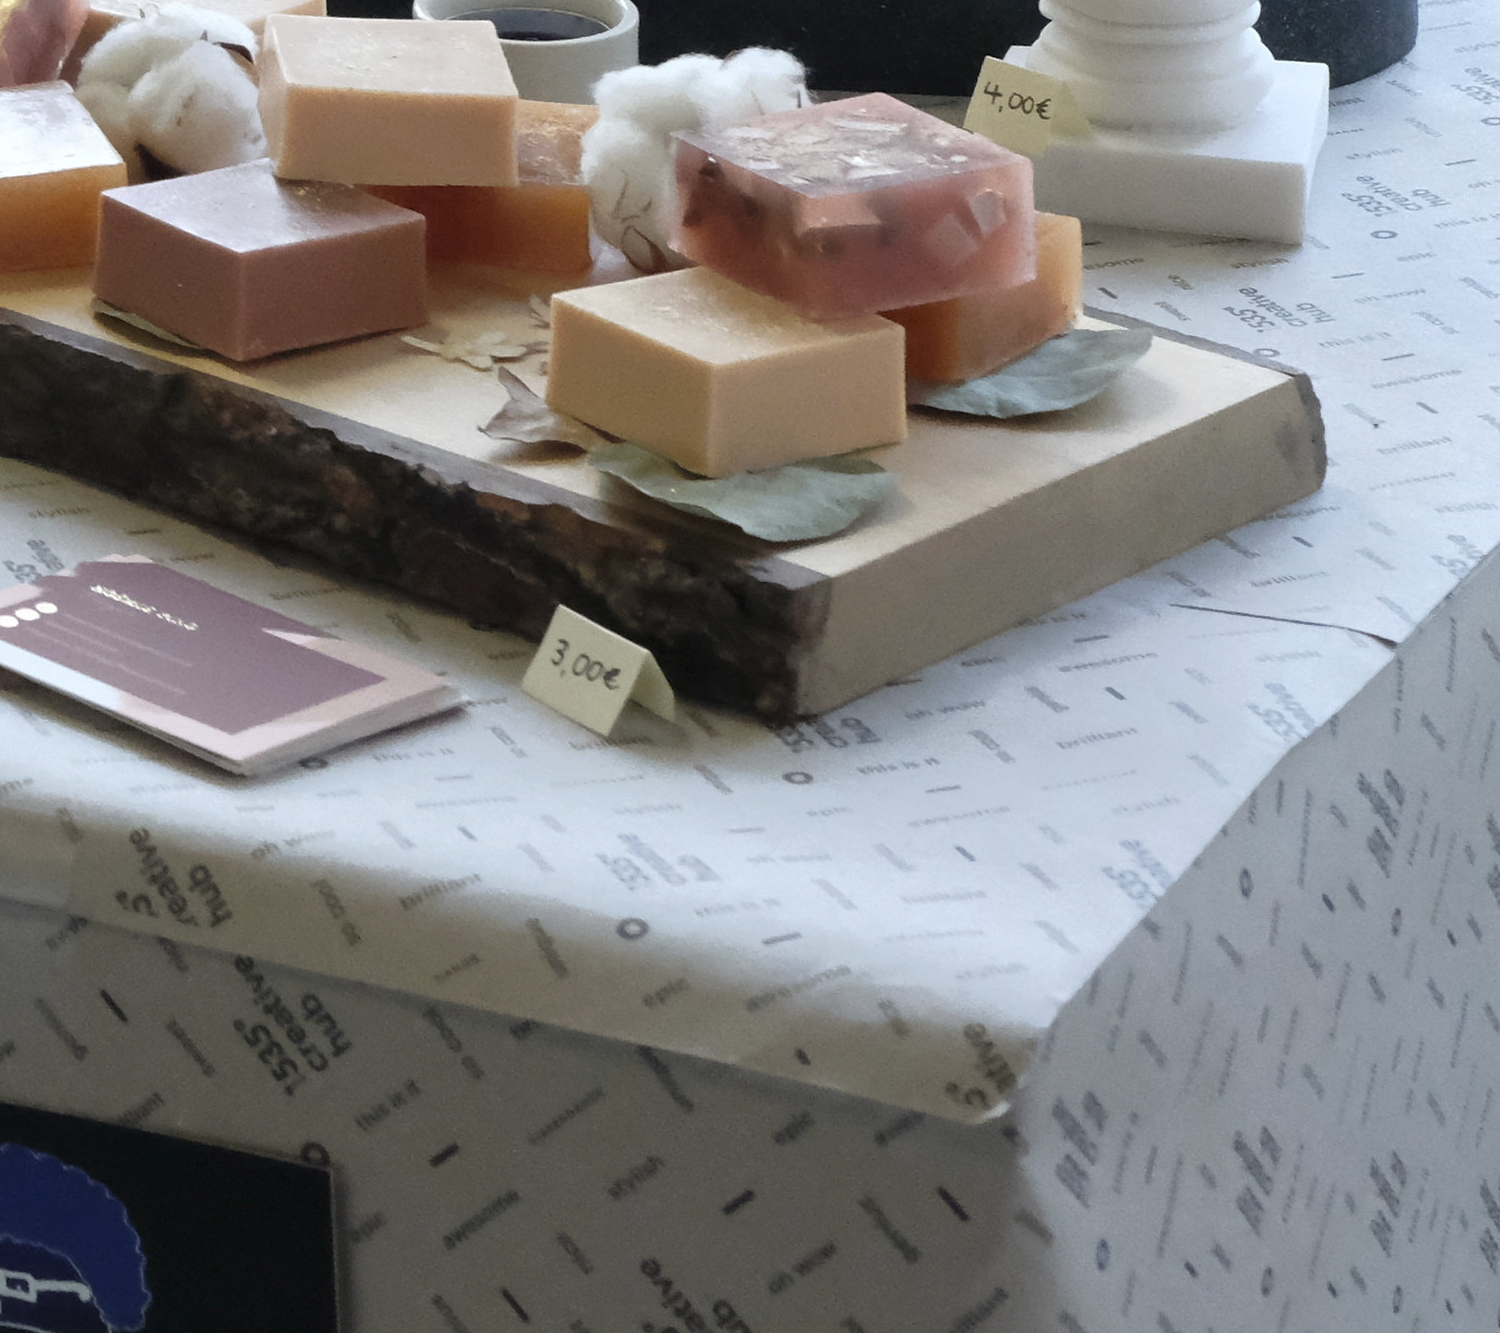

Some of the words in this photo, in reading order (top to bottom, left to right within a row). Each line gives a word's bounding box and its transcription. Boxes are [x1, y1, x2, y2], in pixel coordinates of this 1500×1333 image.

[983, 80, 1052, 121] 4,00€
[1354, 173, 1424, 213] creative
[1410, 186, 1452, 210] hub
[1238, 286, 1309, 329] creative
[550, 637, 622, 691] 3,00€
[187, 862, 234, 930] hub
